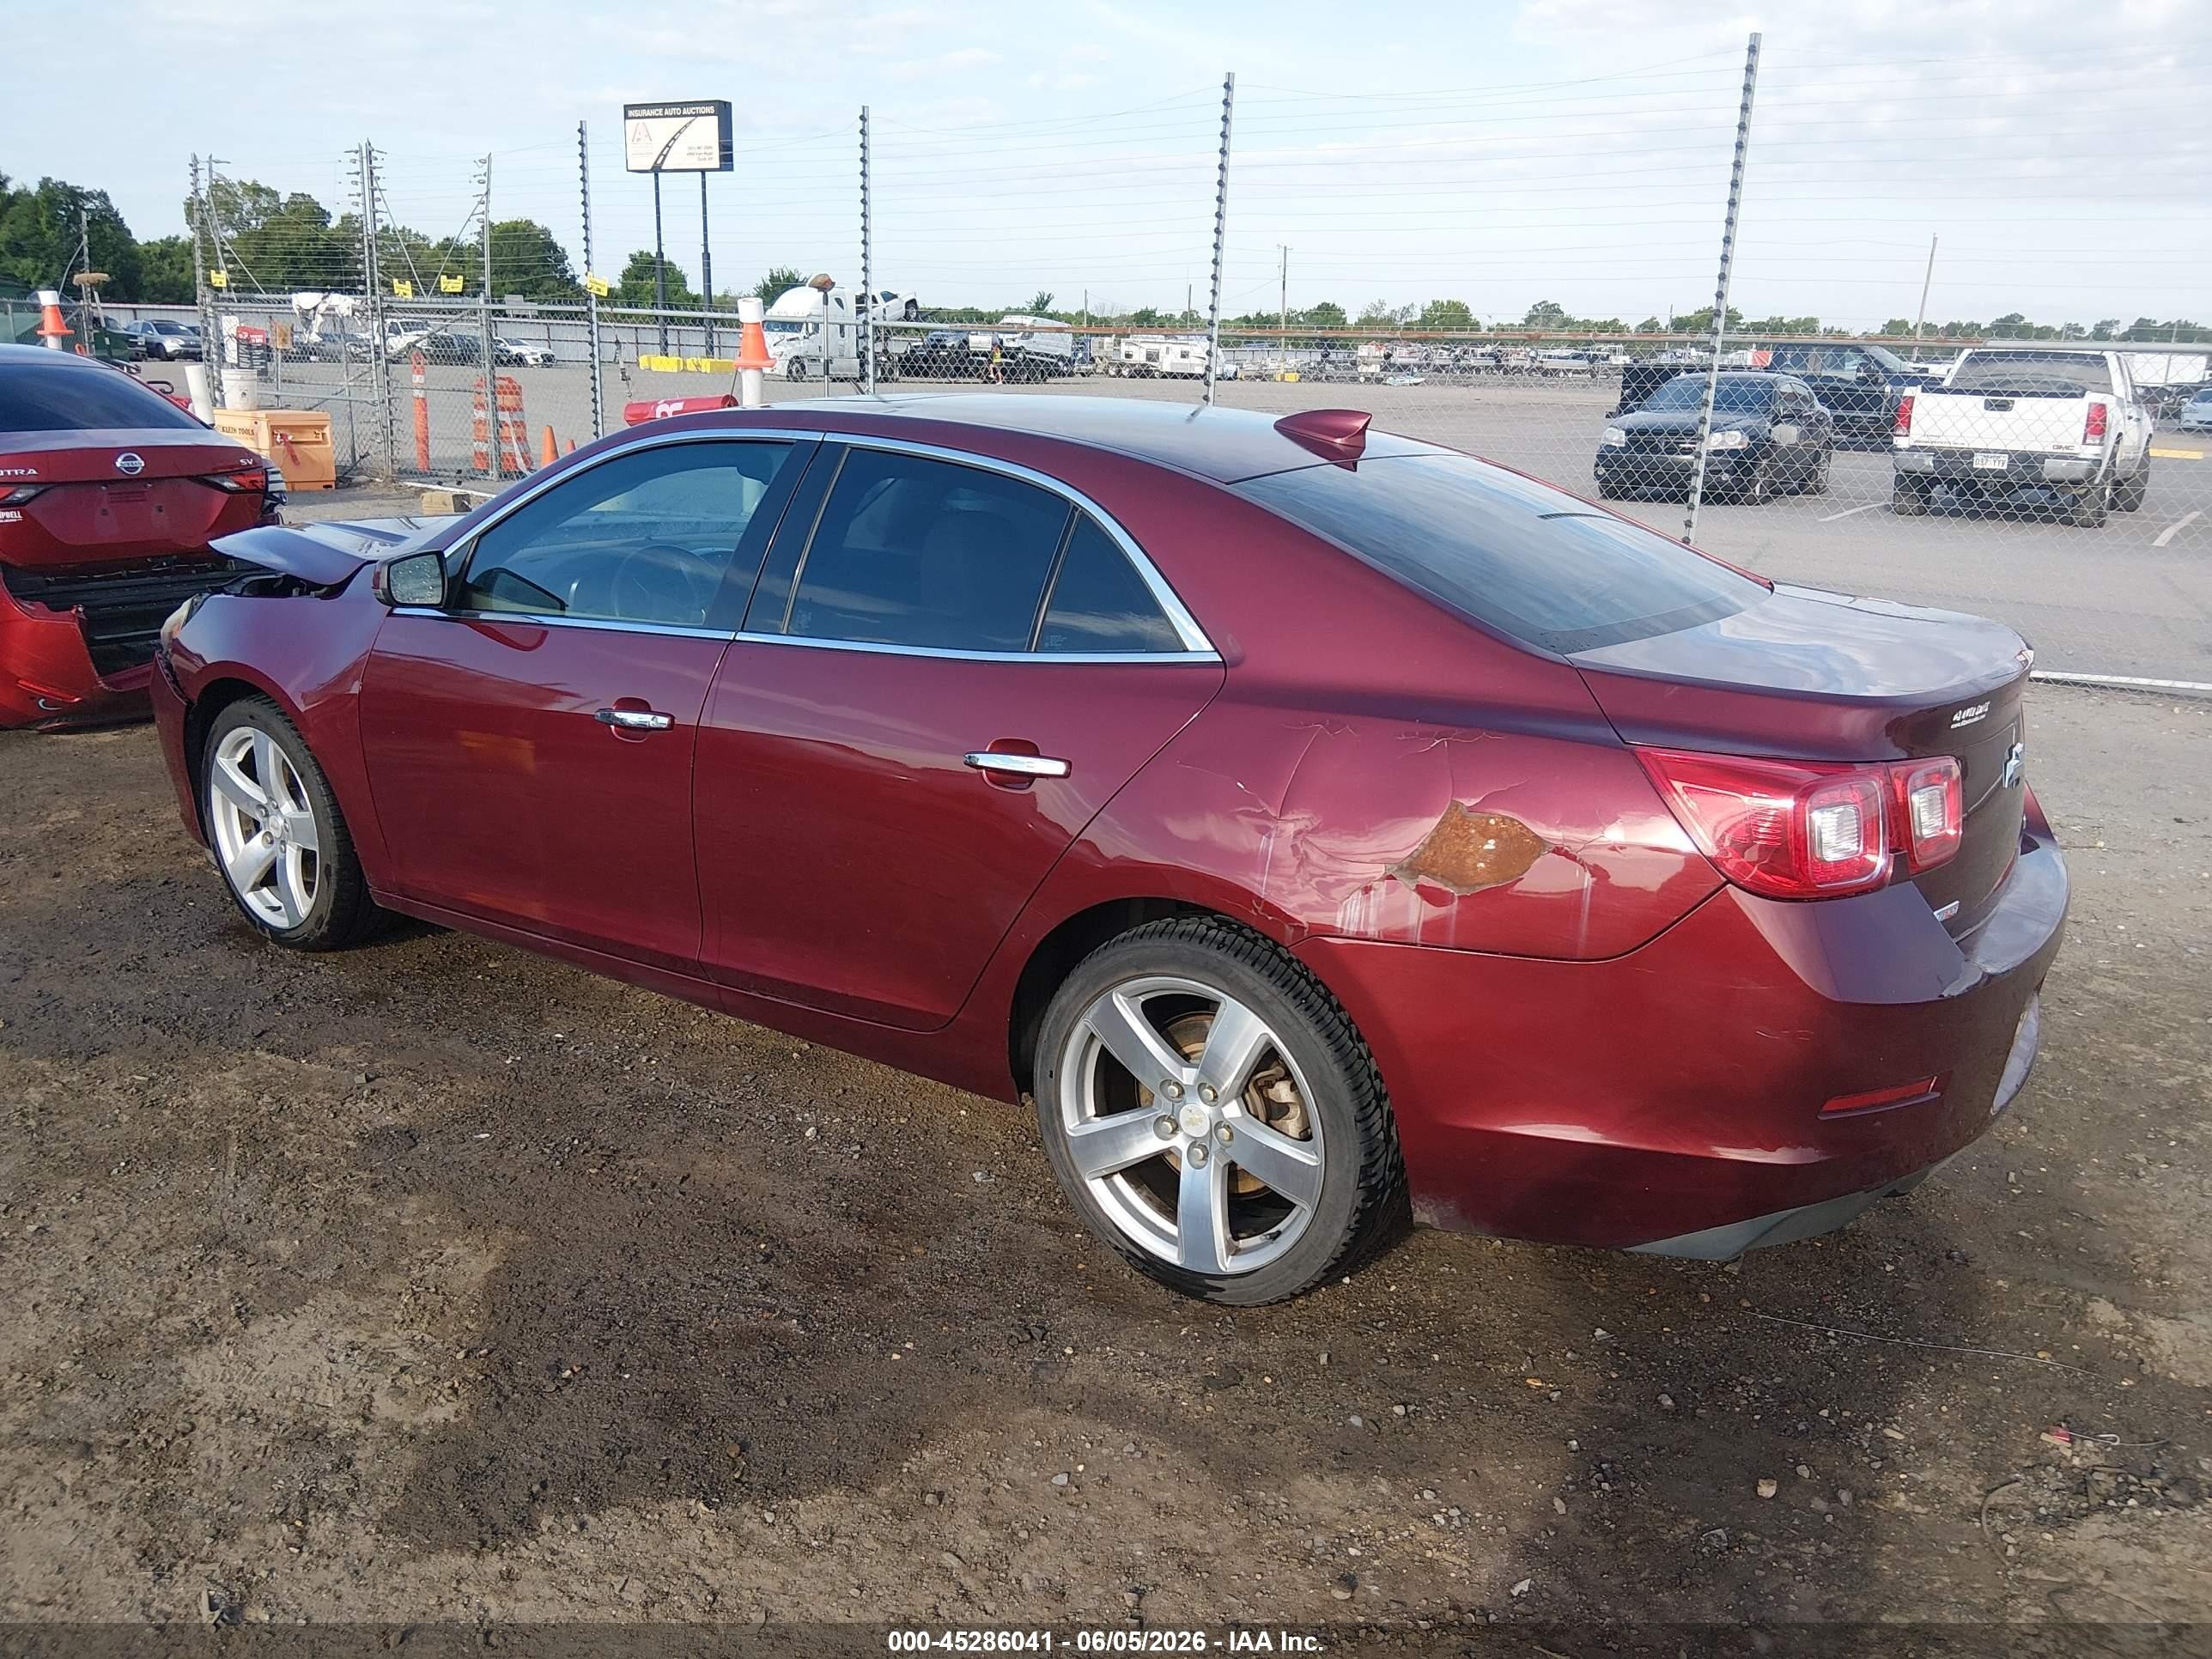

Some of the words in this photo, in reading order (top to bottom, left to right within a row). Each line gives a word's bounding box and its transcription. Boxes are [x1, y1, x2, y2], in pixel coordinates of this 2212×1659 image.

[628, 108, 664, 118] INSURANCE
[664, 107, 681, 116] AUTO
[682, 106, 715, 115] AUCTIONS
[240, 458, 253, 466] SV
